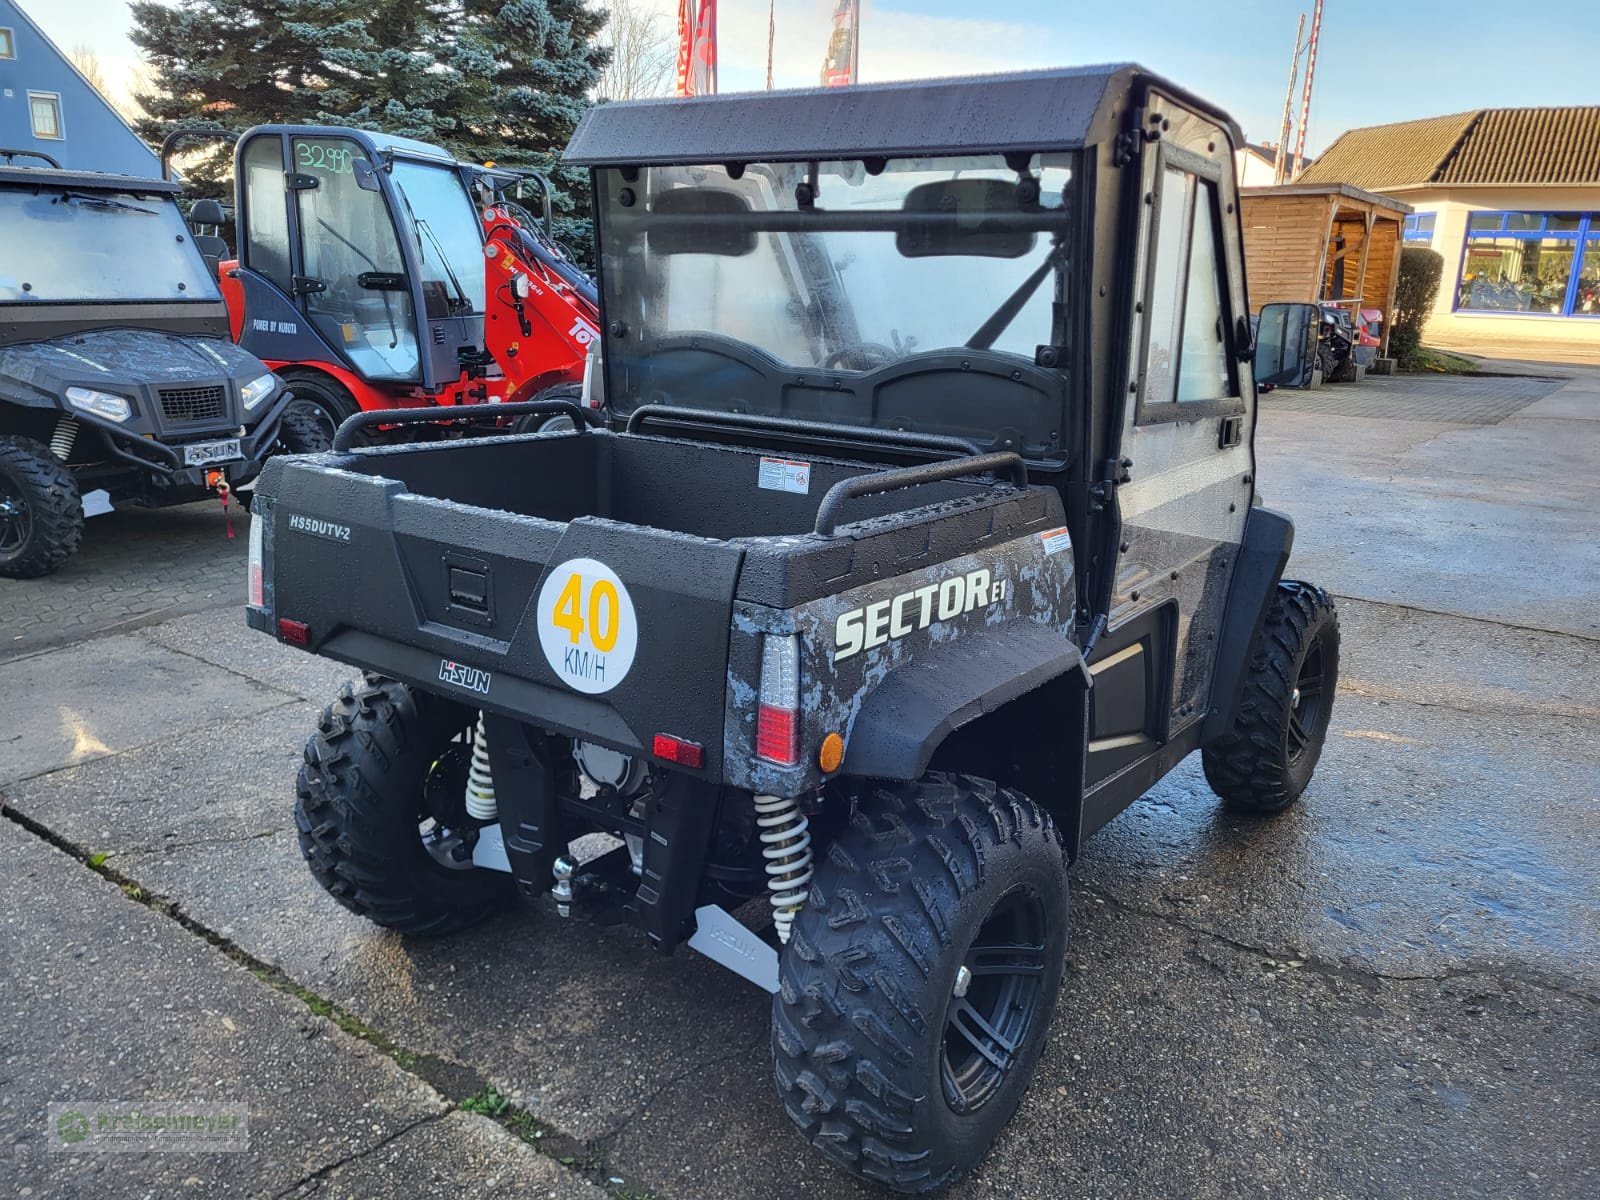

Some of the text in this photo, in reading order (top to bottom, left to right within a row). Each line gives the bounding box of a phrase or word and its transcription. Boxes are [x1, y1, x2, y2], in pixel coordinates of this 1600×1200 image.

[553, 573, 620, 652] 40
[834, 568, 990, 662] SECTOR
[564, 645, 606, 683] KM/H
